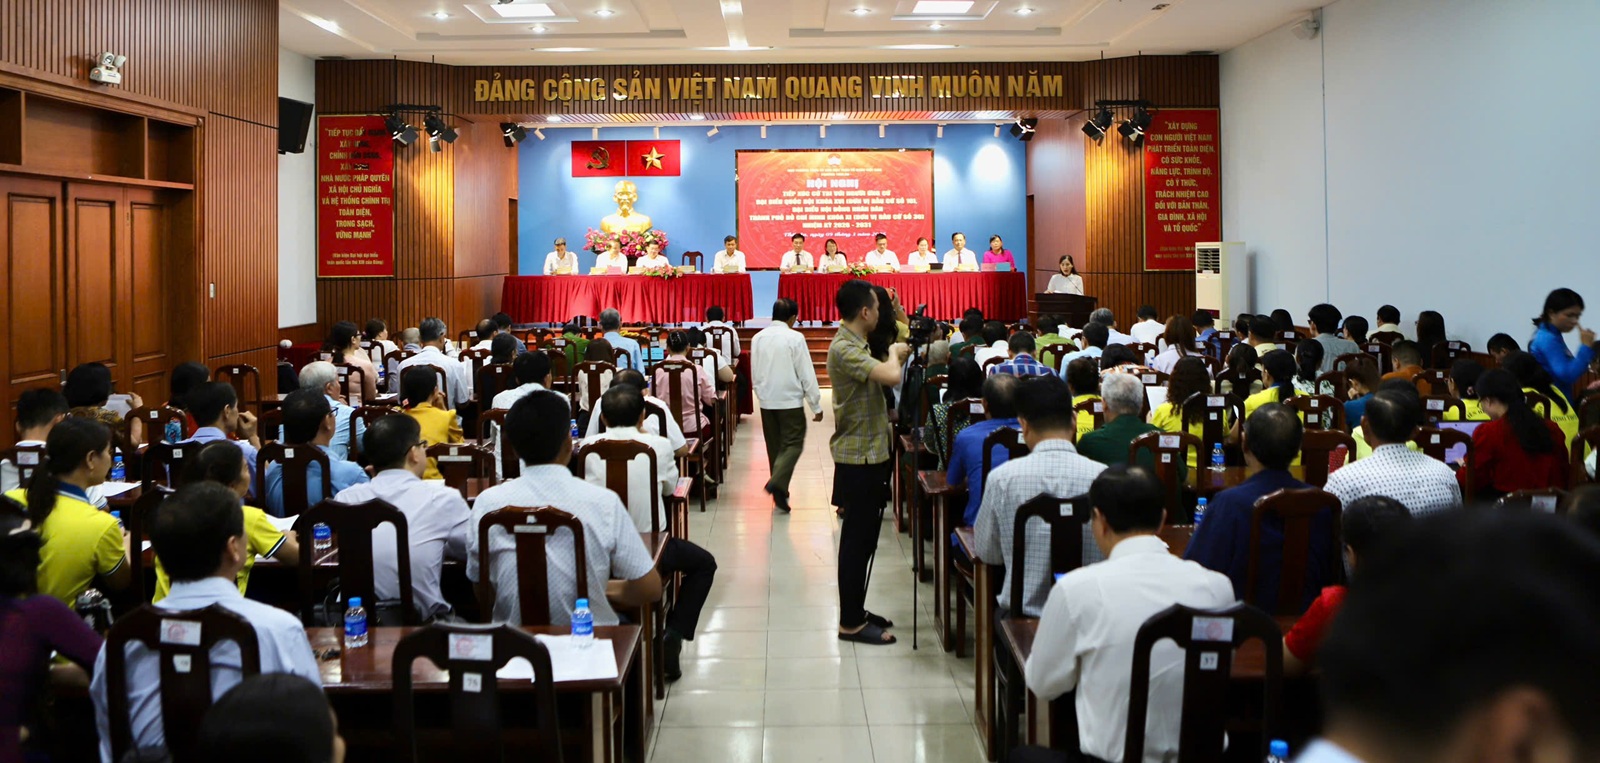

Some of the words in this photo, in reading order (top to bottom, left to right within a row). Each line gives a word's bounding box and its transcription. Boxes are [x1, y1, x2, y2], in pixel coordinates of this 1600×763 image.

[474, 72, 535, 102] ĐẢNG
[543, 73, 606, 106] CỘNG
[612, 70, 661, 100] SẢN
[668, 72, 716, 106] VIỆT
[724, 76, 778, 100] NAM
[784, 76, 862, 100] QUANG
[870, 75, 924, 99] VINH
[930, 70, 1000, 98] MUÔN
[1008, 70, 1064, 98] NĂM
[1181, 122, 1197, 130] DỰNG
[1164, 133, 1182, 141] NGƯỜI
[1184, 133, 1196, 142] VIỆT
[1147, 144, 1162, 152] PHÁT
[1164, 142, 1181, 152] TRIỂN
[1183, 144, 1198, 152] TOÀN
[1161, 155, 1170, 164] CÓ
[1171, 156, 1183, 164] SỨC
[1151, 167, 1168, 175] NĂNG
[1184, 167, 1201, 175] TRÌNH
[353, 173, 368, 182] PHÁP
[370, 173, 390, 182] QUYỀN
[1166, 178, 1174, 186] CÓ
[1176, 178, 1180, 186] Ý
[806, 178, 827, 189] HỘI
[830, 179, 859, 189] NGHỊ
[338, 185, 348, 194] HỘI
[350, 184, 362, 193] CHỦ
[363, 184, 382, 193] NGHĨA
[1155, 190, 1175, 198] TRÁCH
[1176, 190, 1195, 199] NHIỆM
[340, 195, 359, 205] THỐNG
[1155, 200, 1165, 209] ĐỐI
[1167, 201, 1176, 209] VỚI
[1178, 200, 1190, 209] BẢN
[339, 207, 354, 216] TOÀN
[1187, 212, 1195, 220] XÃ
[1197, 212, 1207, 222] HỘI
[1164, 223, 1171, 232] VÀ
[1173, 222, 1180, 232] TỔ
[336, 230, 352, 239] VỮNG
